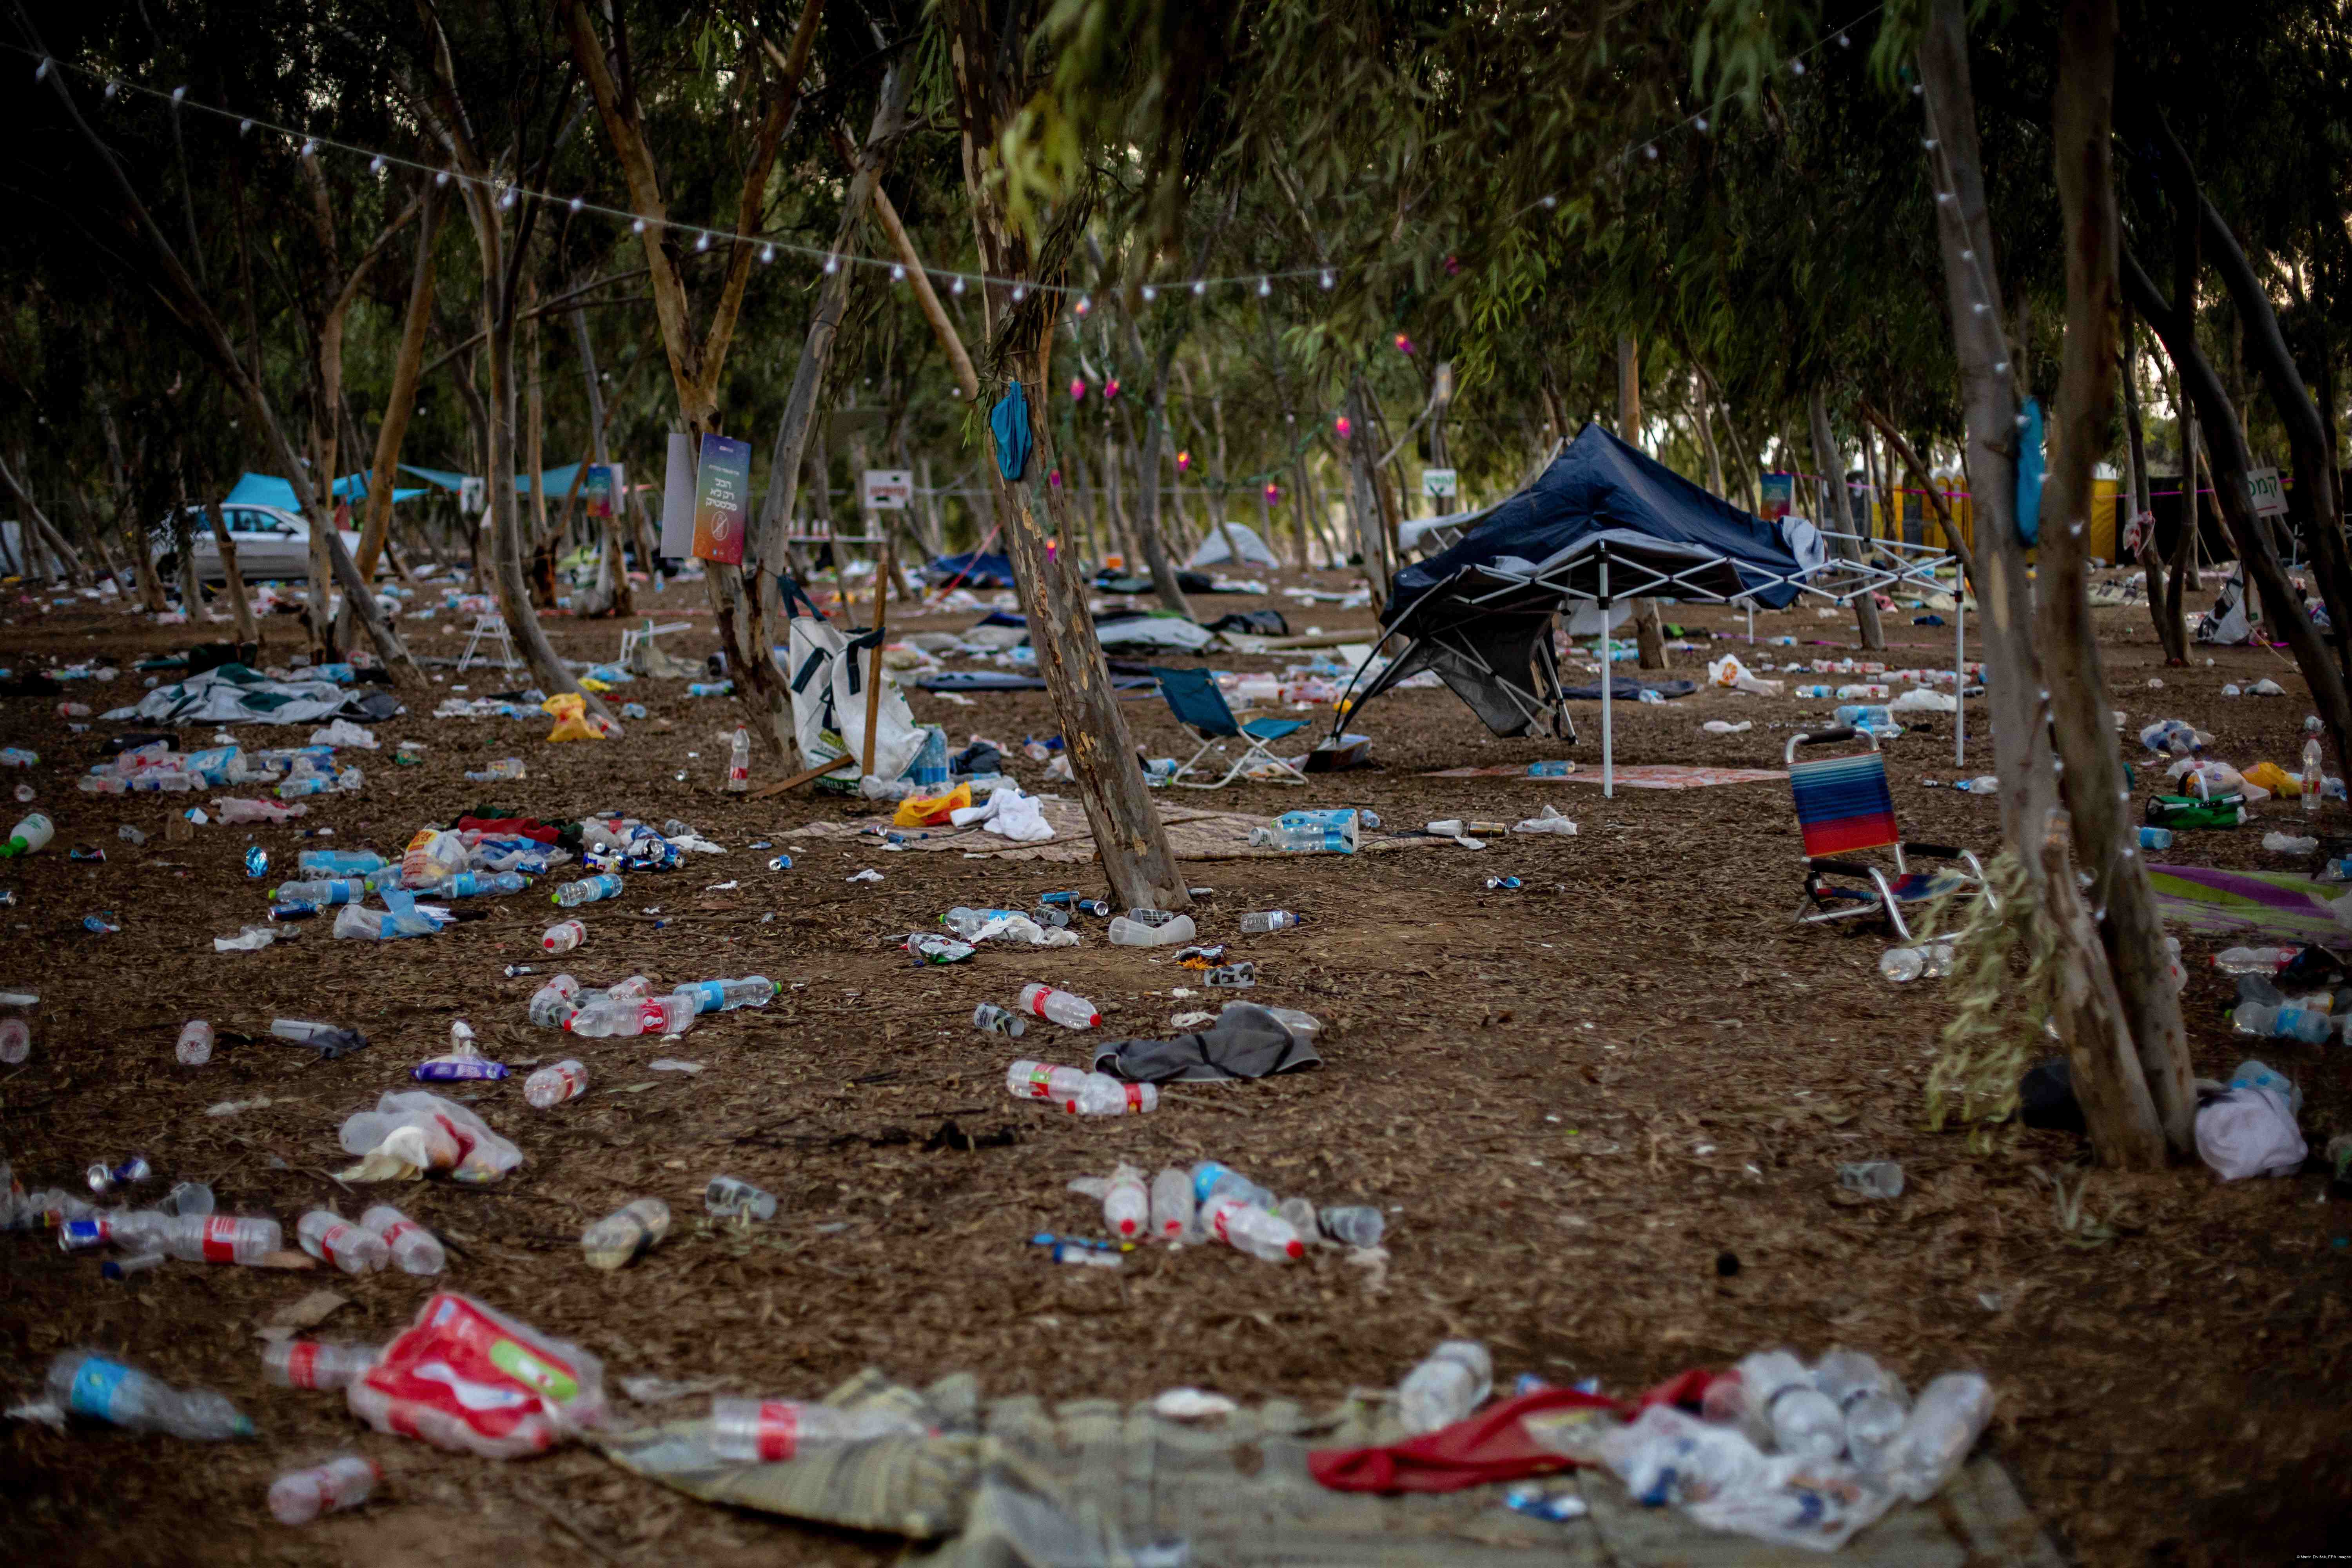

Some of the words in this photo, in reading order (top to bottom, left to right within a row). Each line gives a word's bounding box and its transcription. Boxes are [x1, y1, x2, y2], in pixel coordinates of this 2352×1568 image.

[710, 488, 722, 497] לא
[722, 490, 735, 501] רק
[705, 497, 737, 511] פלסטיק
